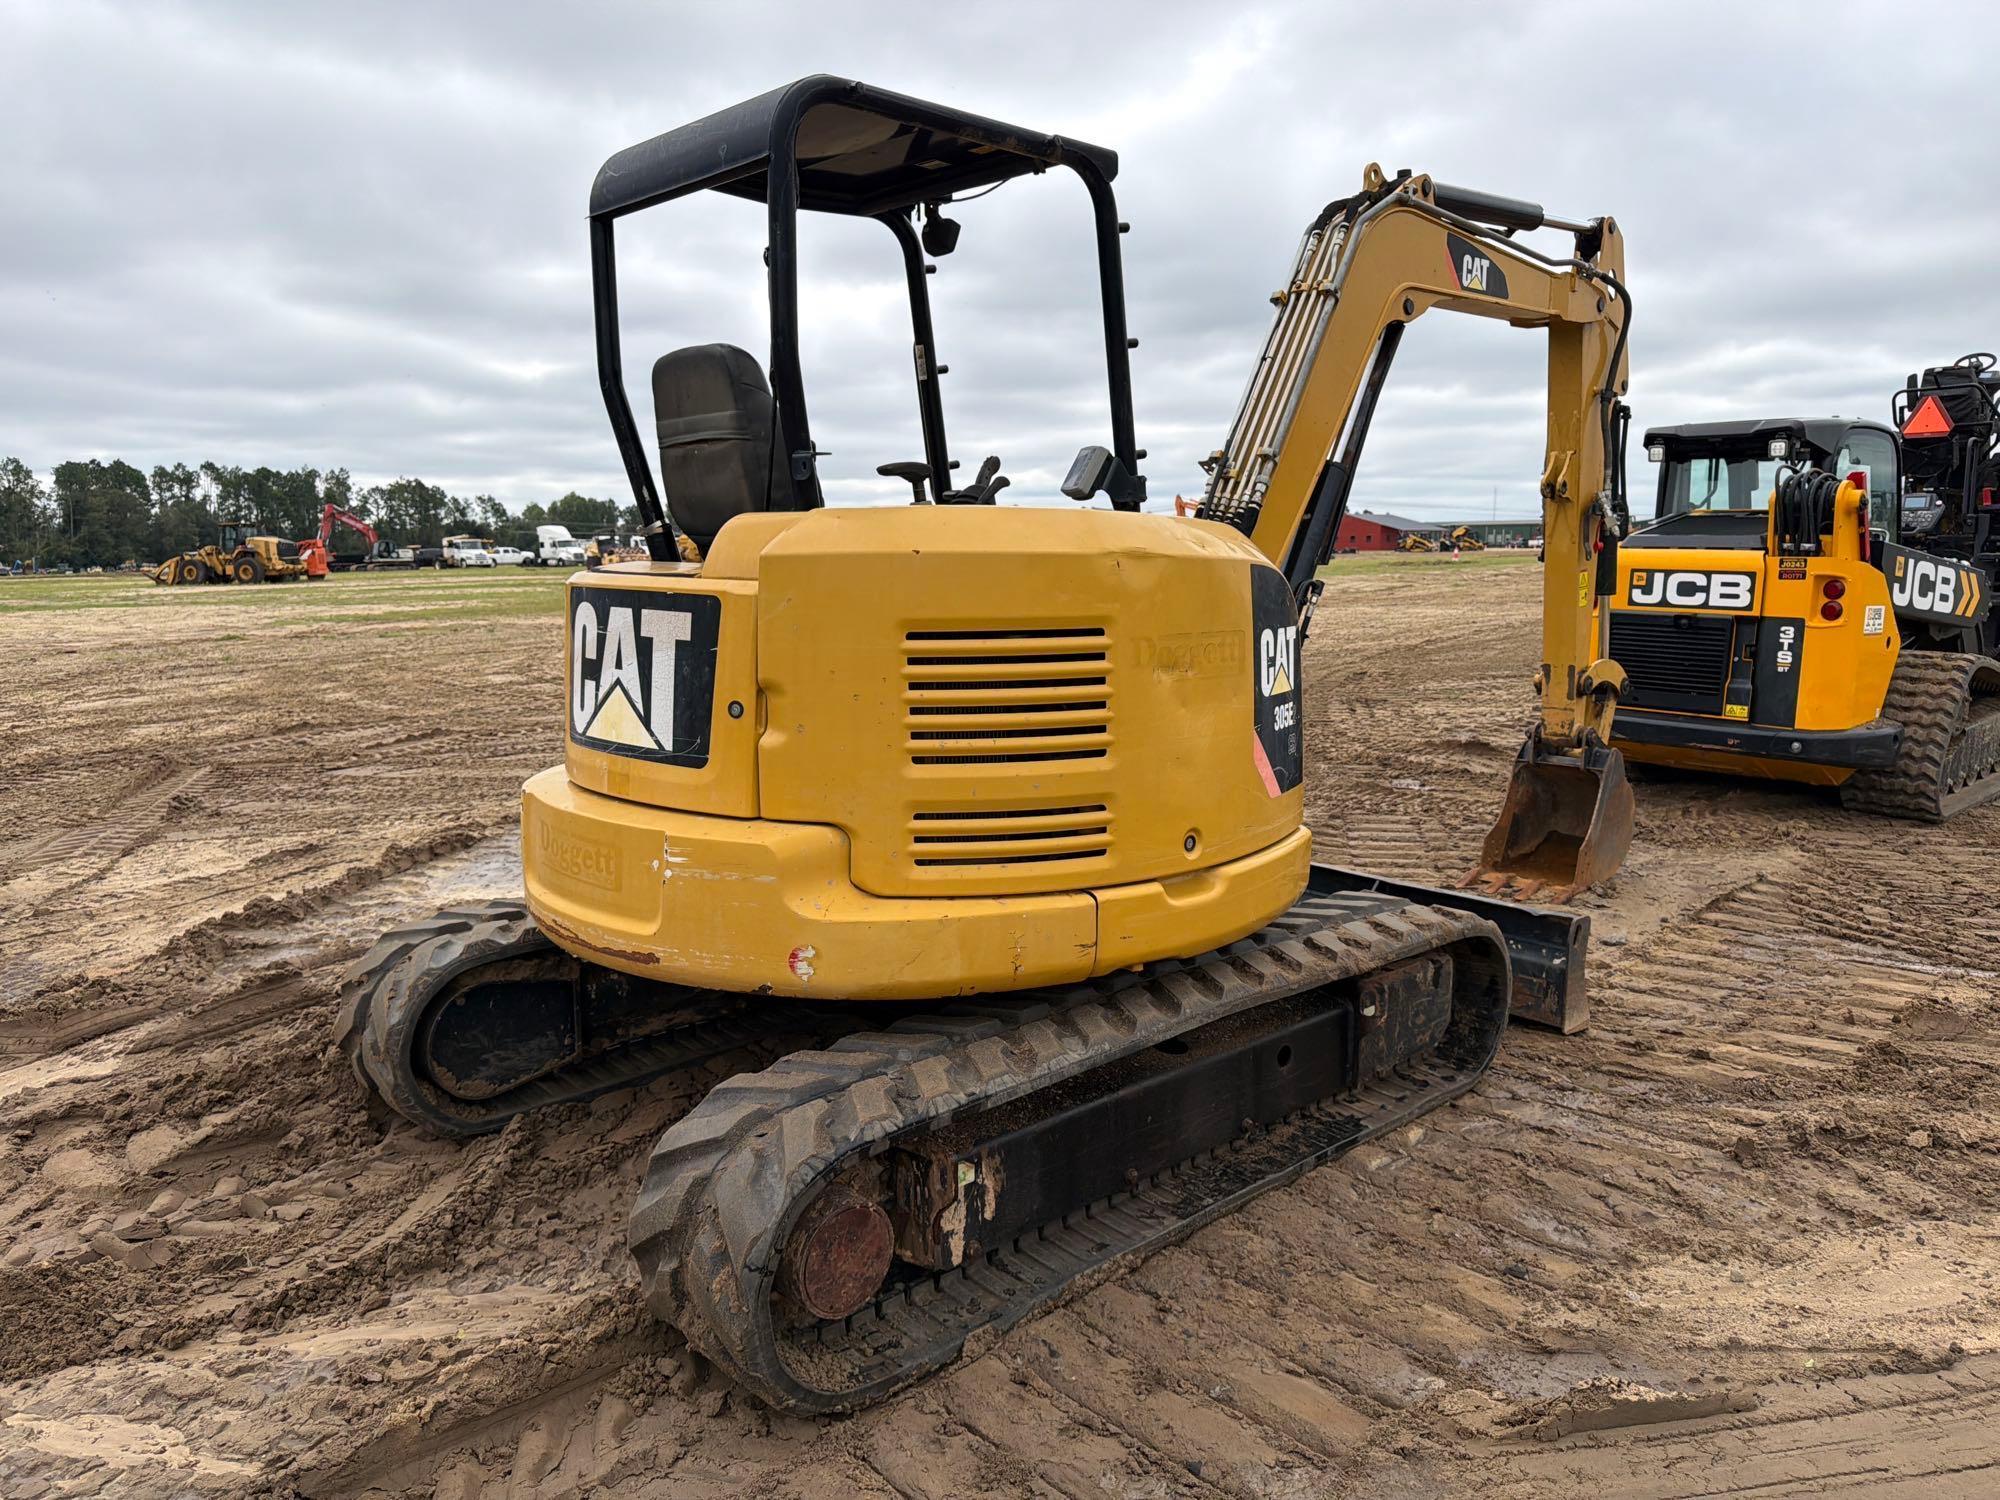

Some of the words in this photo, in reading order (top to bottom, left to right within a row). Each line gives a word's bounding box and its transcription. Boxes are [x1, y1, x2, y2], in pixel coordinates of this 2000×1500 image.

[1462, 254, 1490, 291] CAT
[1632, 572, 1752, 608] JCB
[1893, 558, 1956, 613] JCB
[573, 601, 692, 752] CAT
[1260, 625, 1297, 697] CAT
